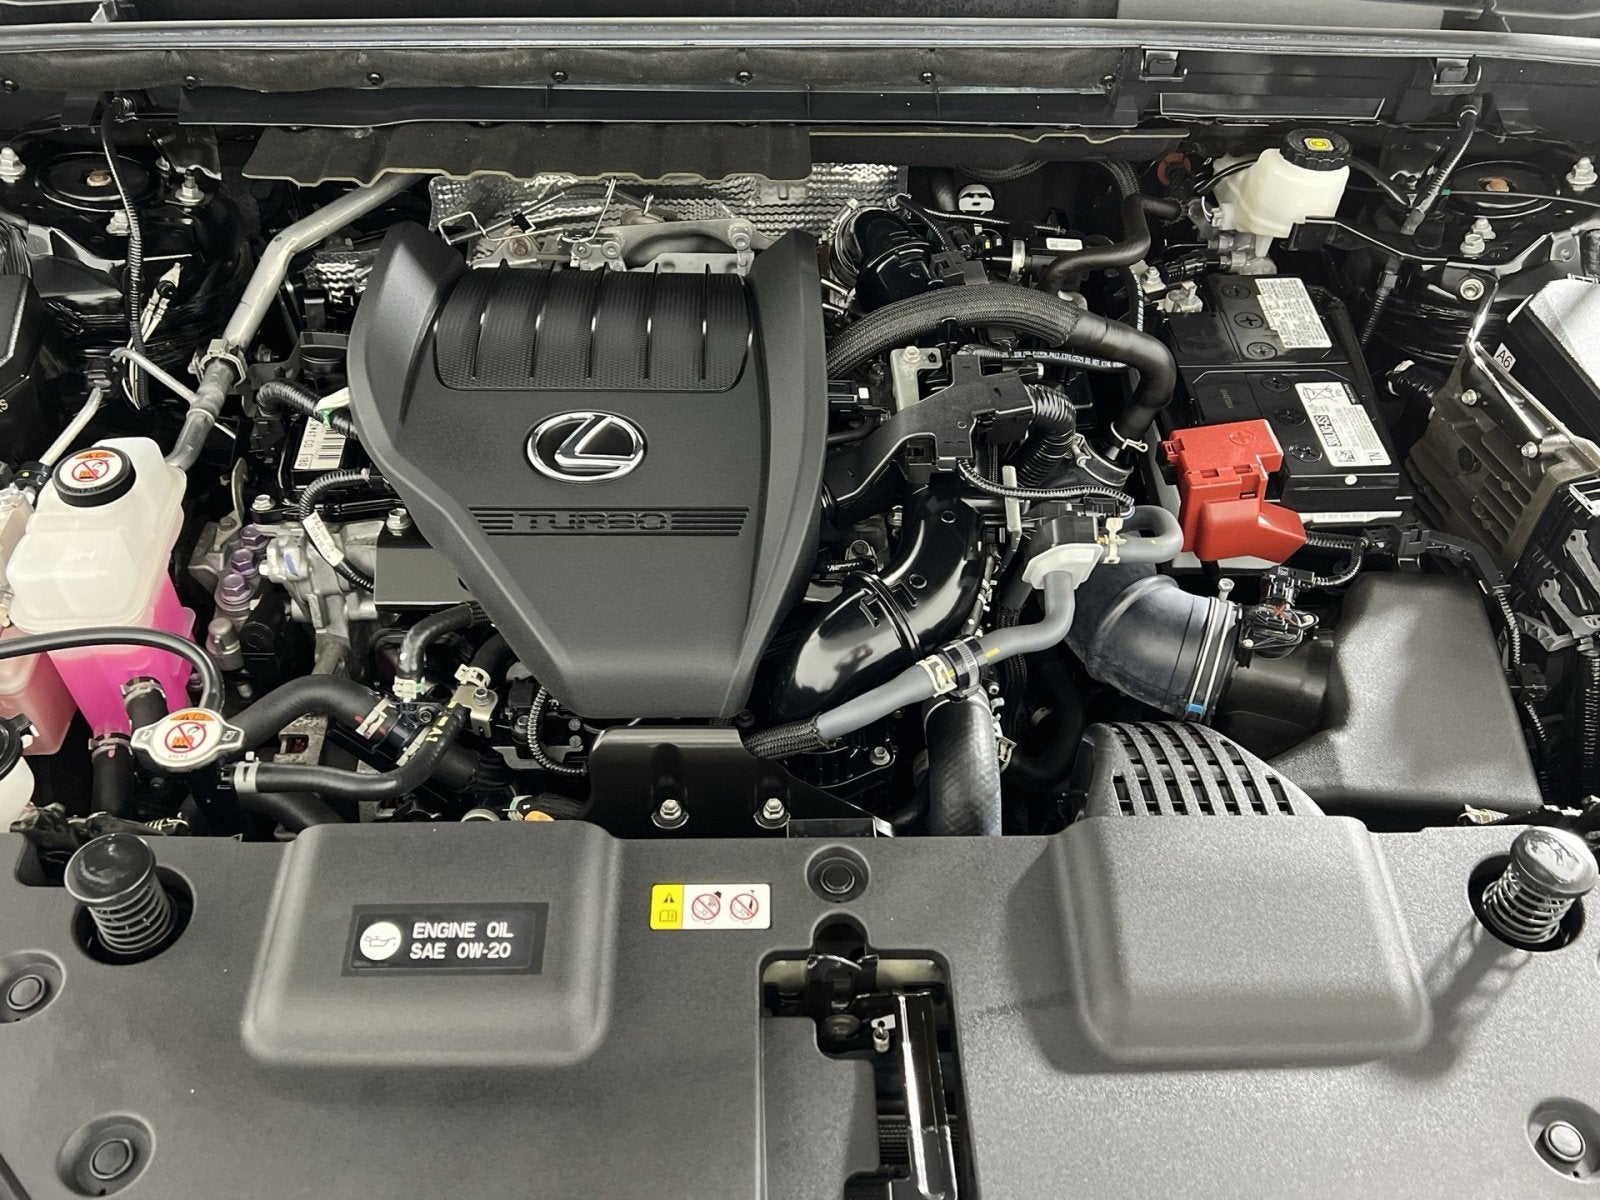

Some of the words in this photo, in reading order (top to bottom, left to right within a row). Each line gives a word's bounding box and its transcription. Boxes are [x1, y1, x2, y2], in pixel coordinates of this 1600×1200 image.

[1496, 349, 1513, 369] A6
[518, 511, 668, 530] TURBO
[412, 921, 477, 939] ENGINE
[486, 921, 515, 939] OIL
[409, 941, 446, 960] SAE
[456, 941, 512, 960] 0W-20
